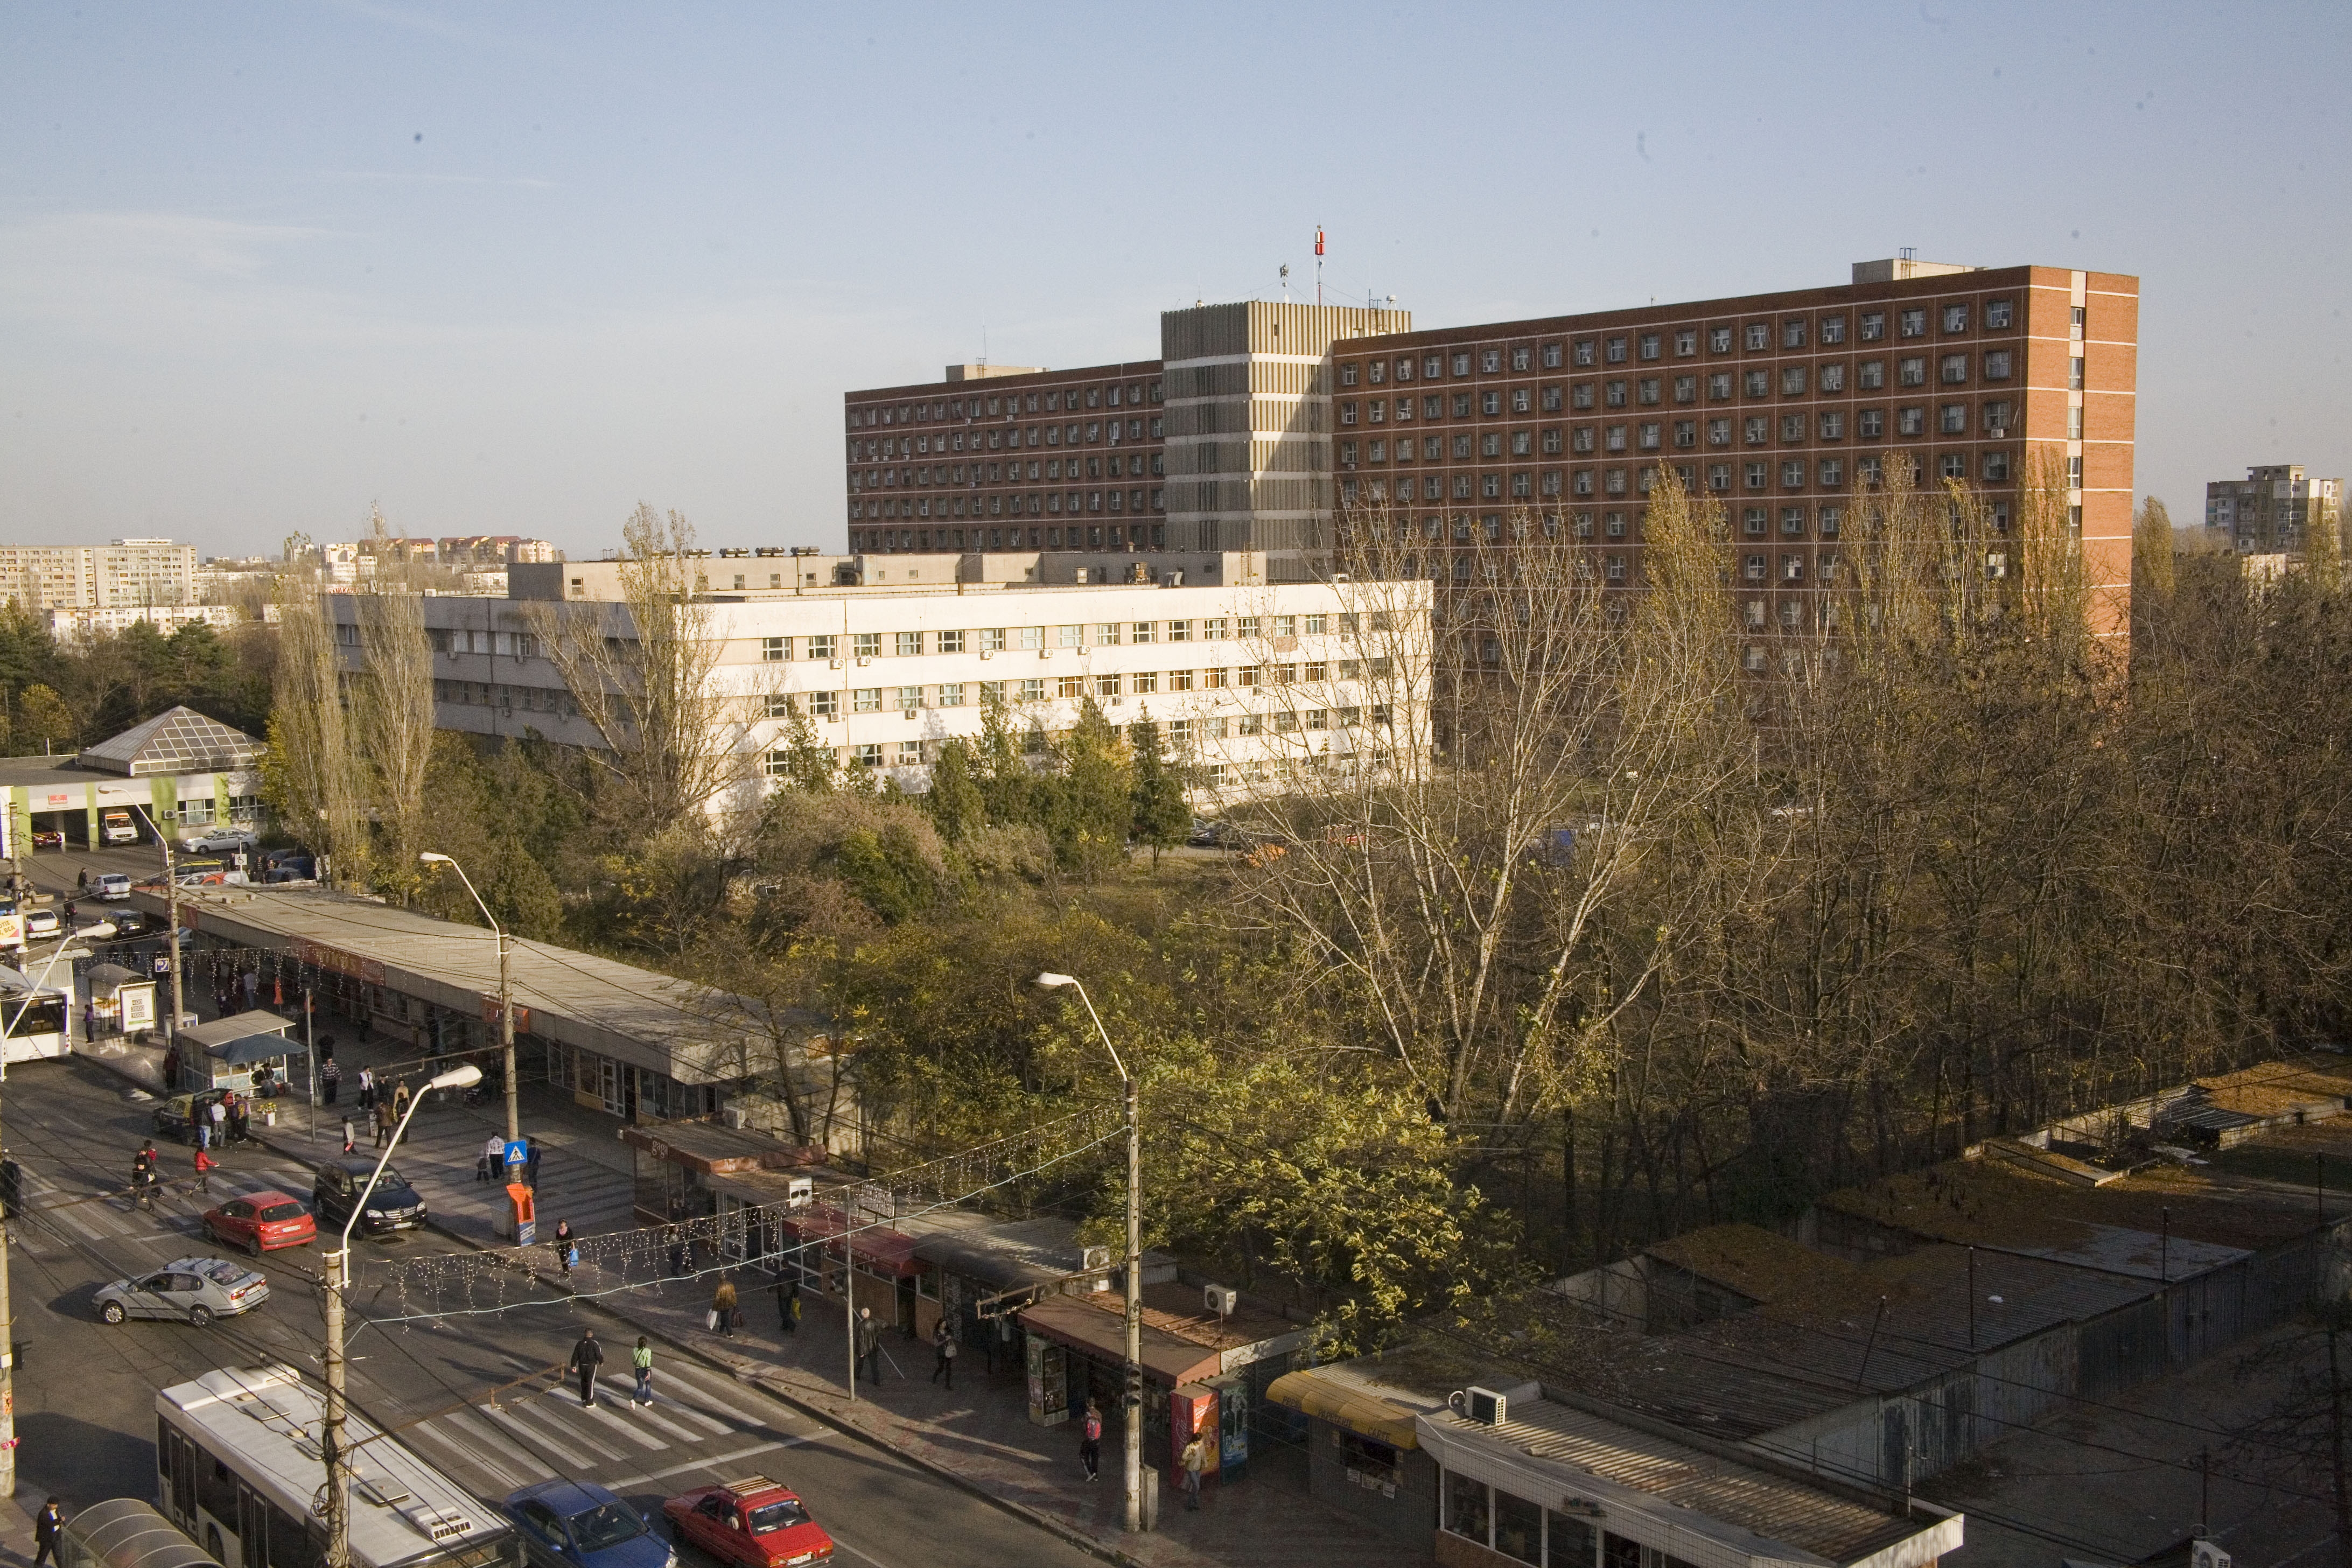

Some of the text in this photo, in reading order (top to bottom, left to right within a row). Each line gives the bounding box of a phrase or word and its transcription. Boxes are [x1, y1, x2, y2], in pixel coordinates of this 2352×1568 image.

[652, 1140, 668, 1159] gaga
[839, 1243, 877, 1263] MDICALA
[1367, 1427, 1391, 1442] CARTE
